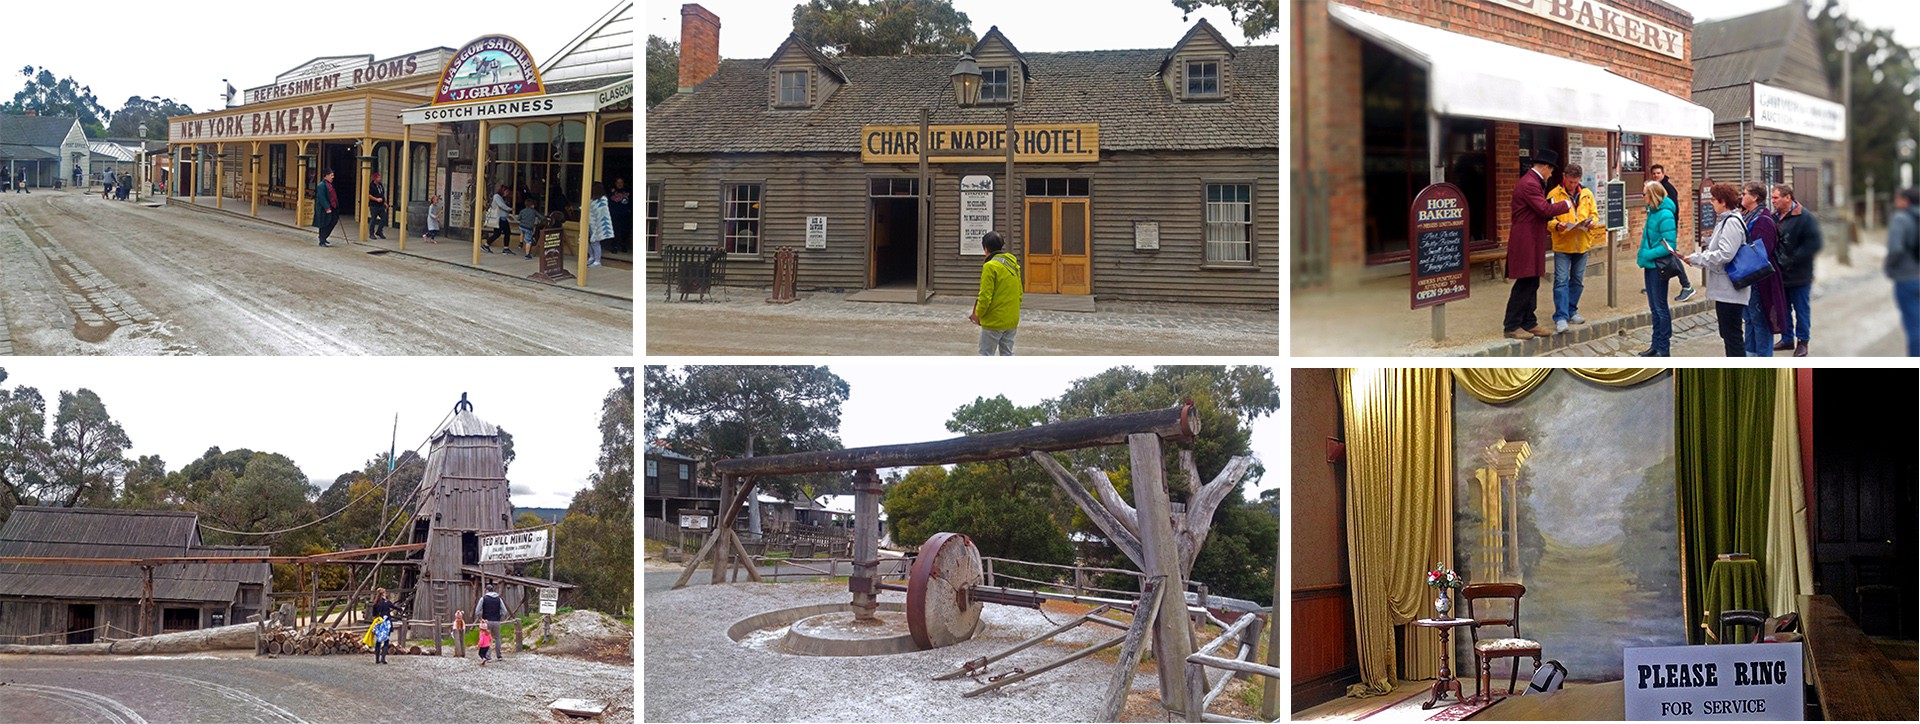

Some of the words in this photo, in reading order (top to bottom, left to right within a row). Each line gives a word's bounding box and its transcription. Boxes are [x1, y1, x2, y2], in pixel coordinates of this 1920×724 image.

[1549, 0, 1679, 54] BAKERY
[254, 73, 341, 101] REFRESHMENT
[353, 55, 418, 84] ROOMS
[425, 107, 472, 120] SCOTCH
[478, 99, 554, 116] HARNESS
[181, 121, 202, 139] NEW
[208, 115, 244, 137] YORK
[252, 104, 335, 135] BAKERY,
[867, 131, 946, 155] CHARIE
[1024, 129, 1093, 155] HOTEL.
[1427, 198, 1457, 210] HOPE
[1418, 208, 1464, 222] BAKERY
[1416, 289, 1437, 300] OPEN
[494, 536, 508, 546] HILL
[510, 533, 533, 544] MINING
[1637, 663, 1718, 689] PLEASE
[1734, 660, 1787, 686] RING
[1661, 702, 1693, 716] FOR
[1704, 699, 1766, 715] SERVICE
